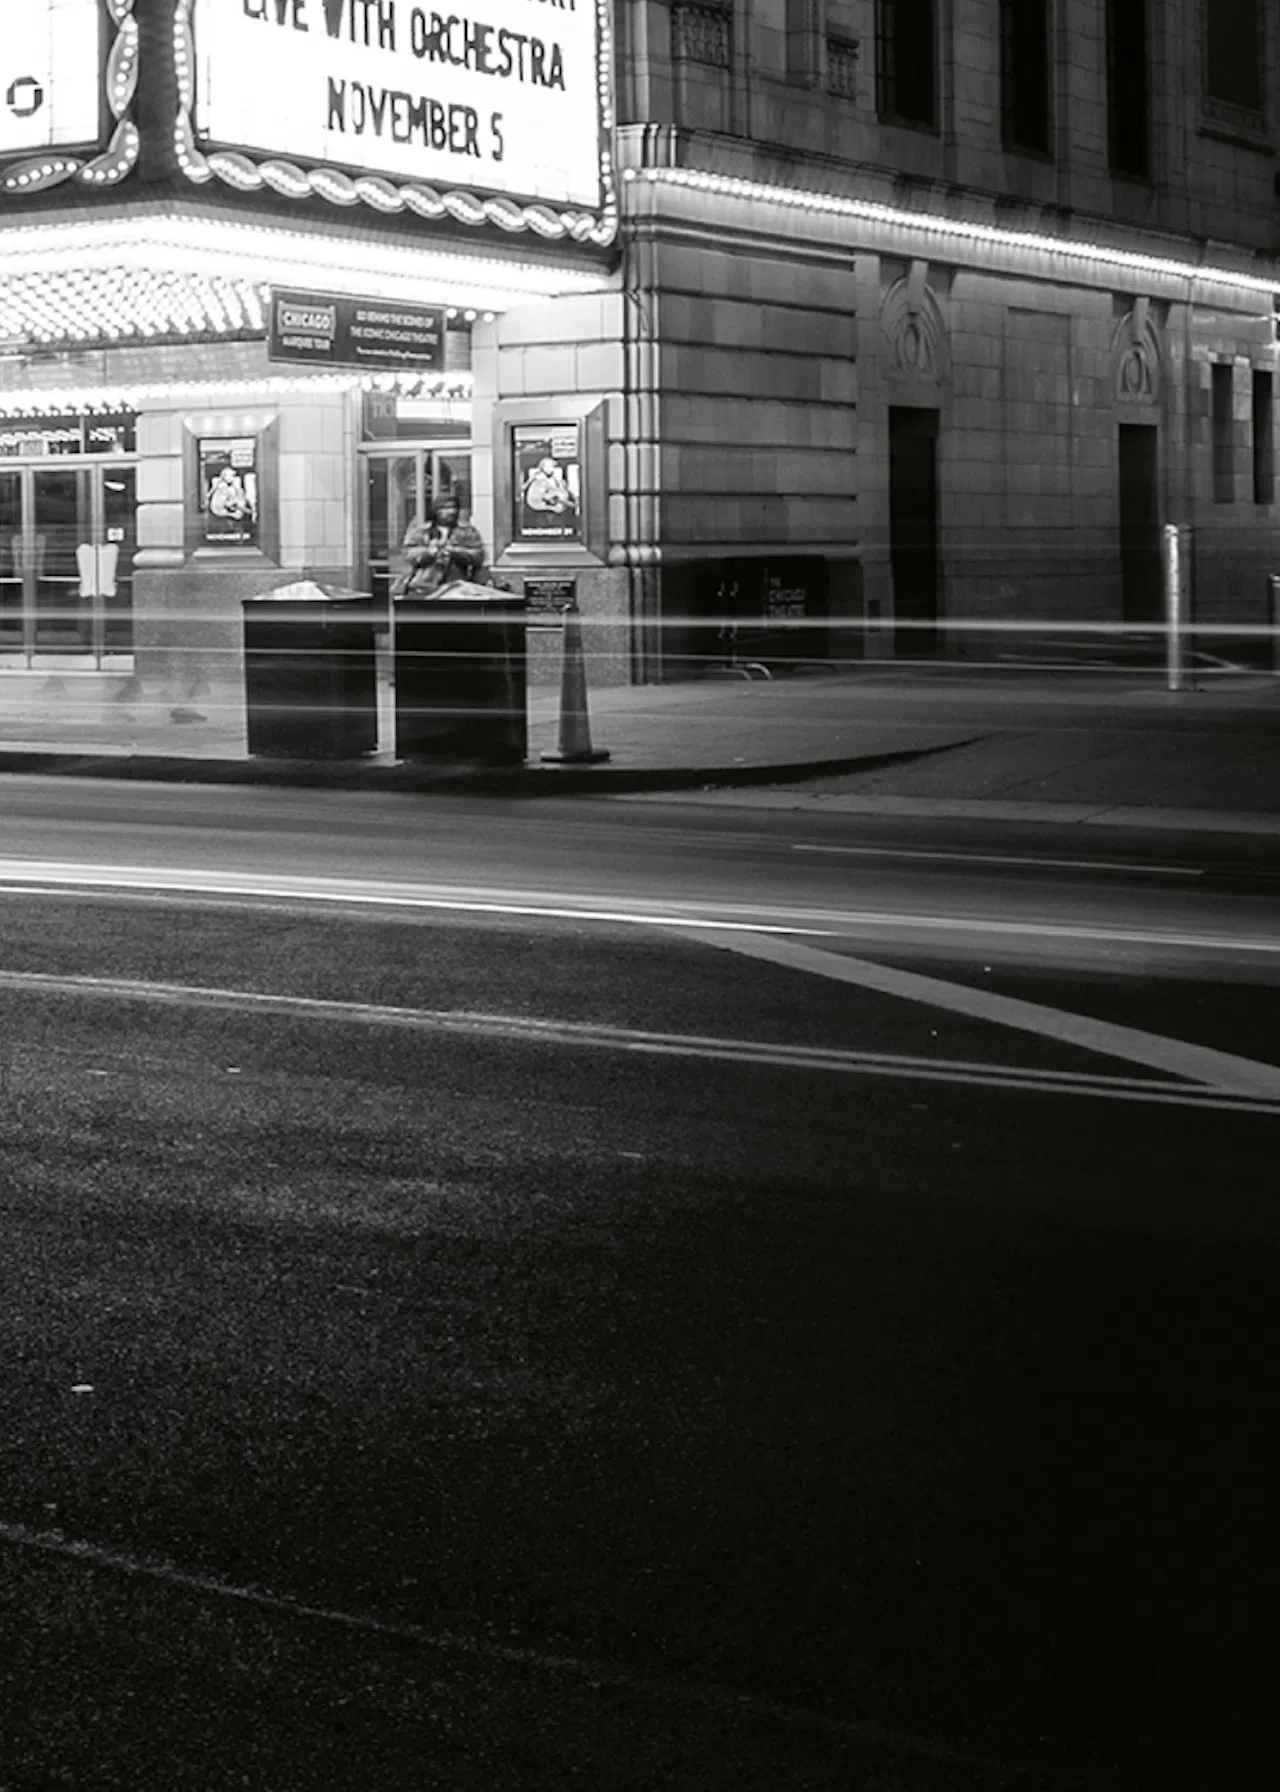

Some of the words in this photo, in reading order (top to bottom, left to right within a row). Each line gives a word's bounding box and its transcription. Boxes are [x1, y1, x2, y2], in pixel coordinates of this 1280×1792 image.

[410, 6, 567, 93] ORCHESTRA
[326, 76, 481, 161] NOVEMBER
[491, 112, 504, 162] 5
[283, 310, 330, 330] CHICAGO
